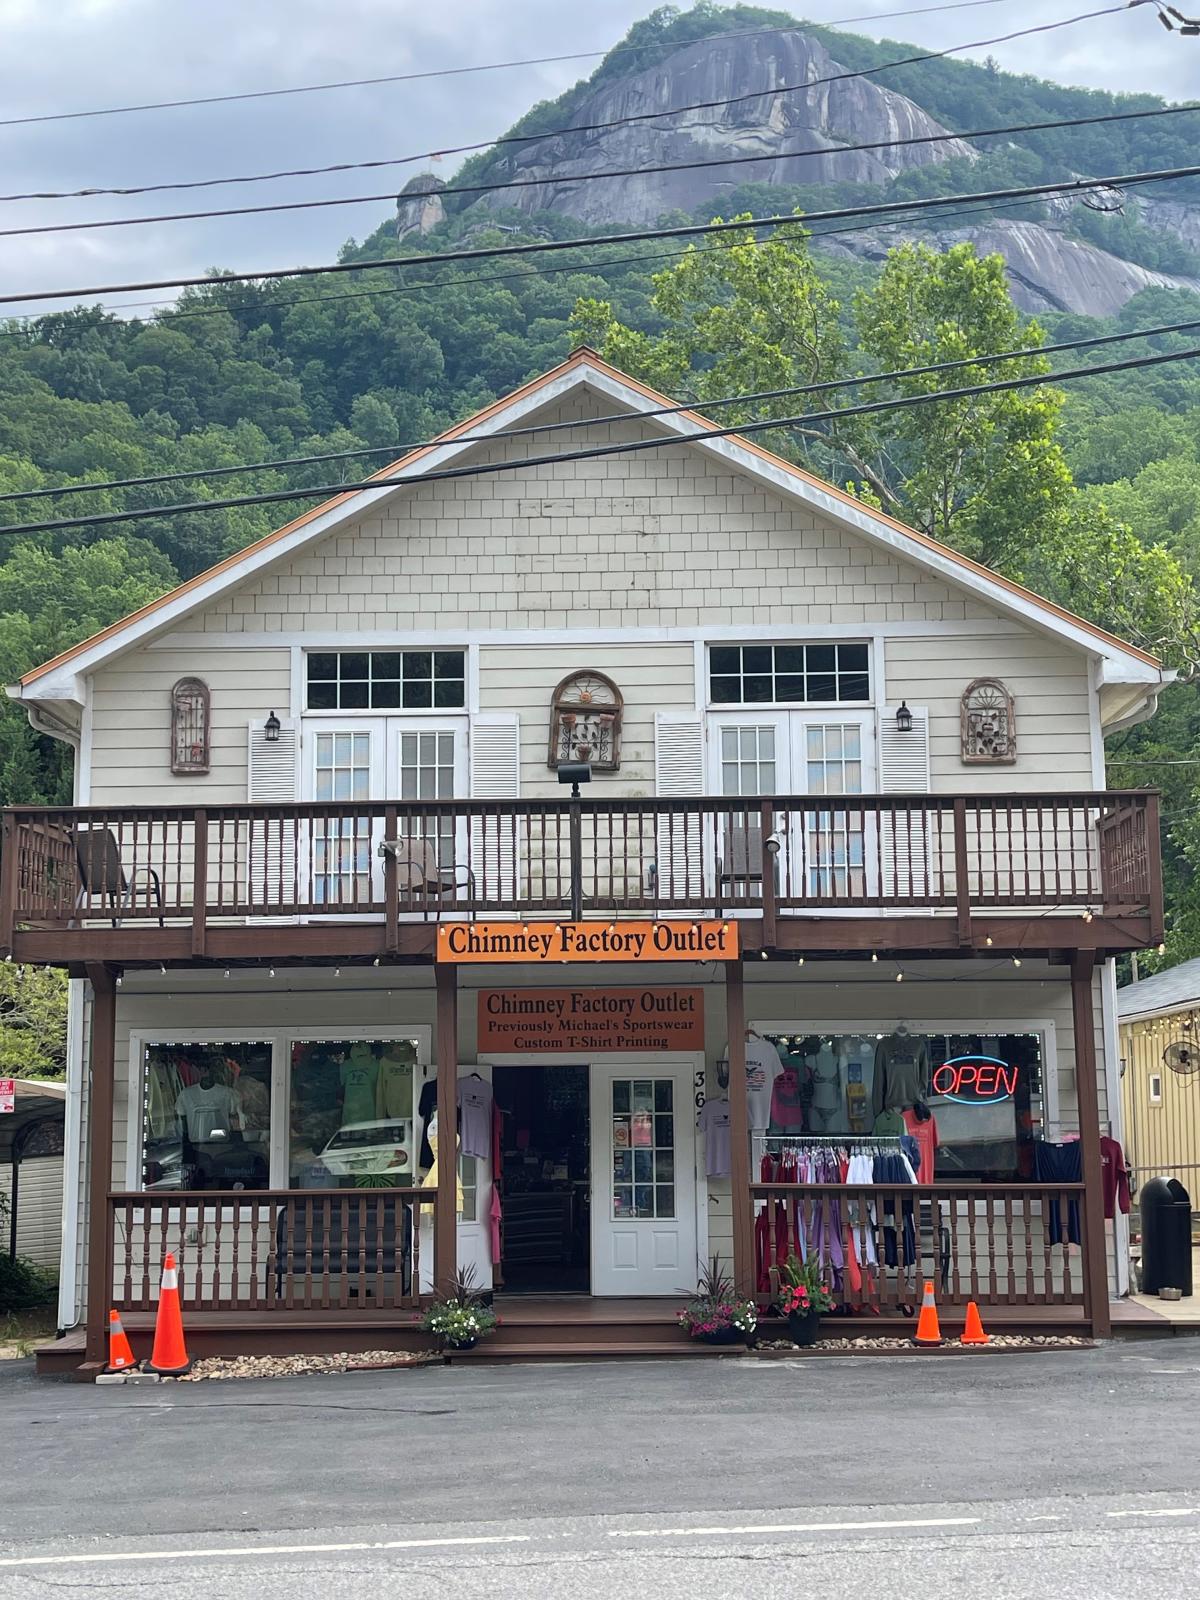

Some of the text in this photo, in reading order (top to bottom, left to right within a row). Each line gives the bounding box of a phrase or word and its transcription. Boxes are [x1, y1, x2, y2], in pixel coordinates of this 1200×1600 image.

[449, 925, 726, 958] Chimney Factory Outlet
[487, 991, 695, 1018] Chimney Factory Outlet
[488, 1019, 694, 1034] Previously Michael's Sportswear
[514, 1035, 669, 1049] Custom T-Shirt Printing
[933, 1065, 1018, 1094] OPEN
